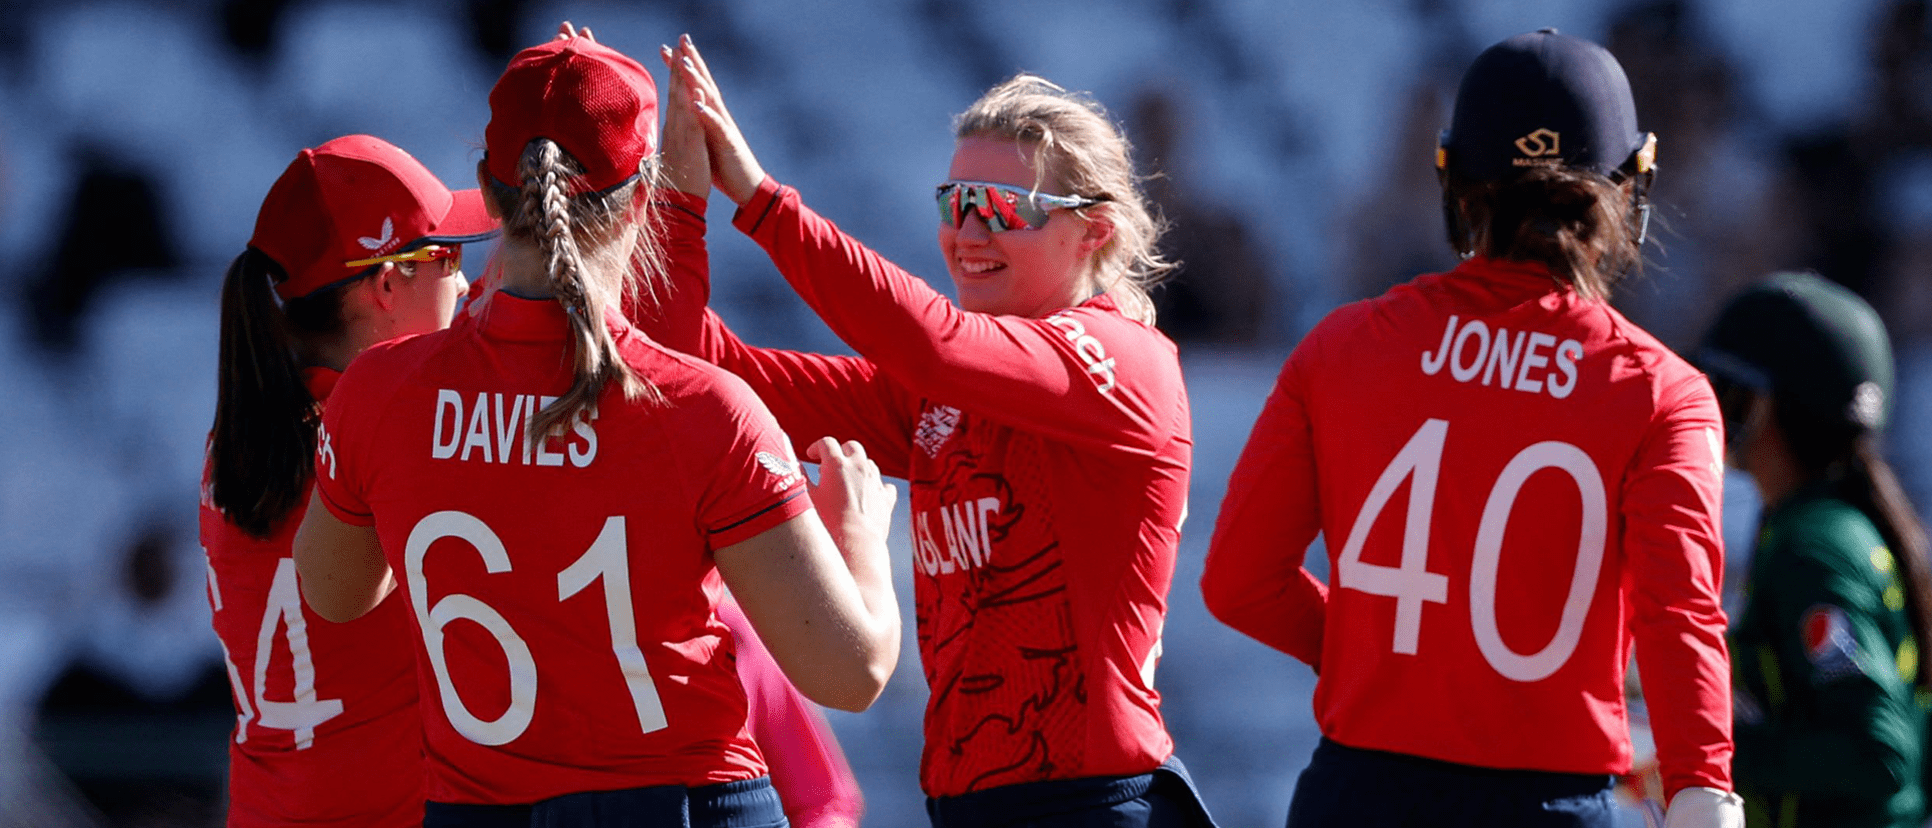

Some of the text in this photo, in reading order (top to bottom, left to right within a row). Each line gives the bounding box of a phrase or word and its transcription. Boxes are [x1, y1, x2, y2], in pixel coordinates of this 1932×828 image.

[1045, 310, 1116, 394] nch
[1421, 315, 1584, 399] JONES
[432, 389, 599, 468] DAVIES
[1338, 418, 1608, 682] 40
[405, 511, 669, 746] 61
